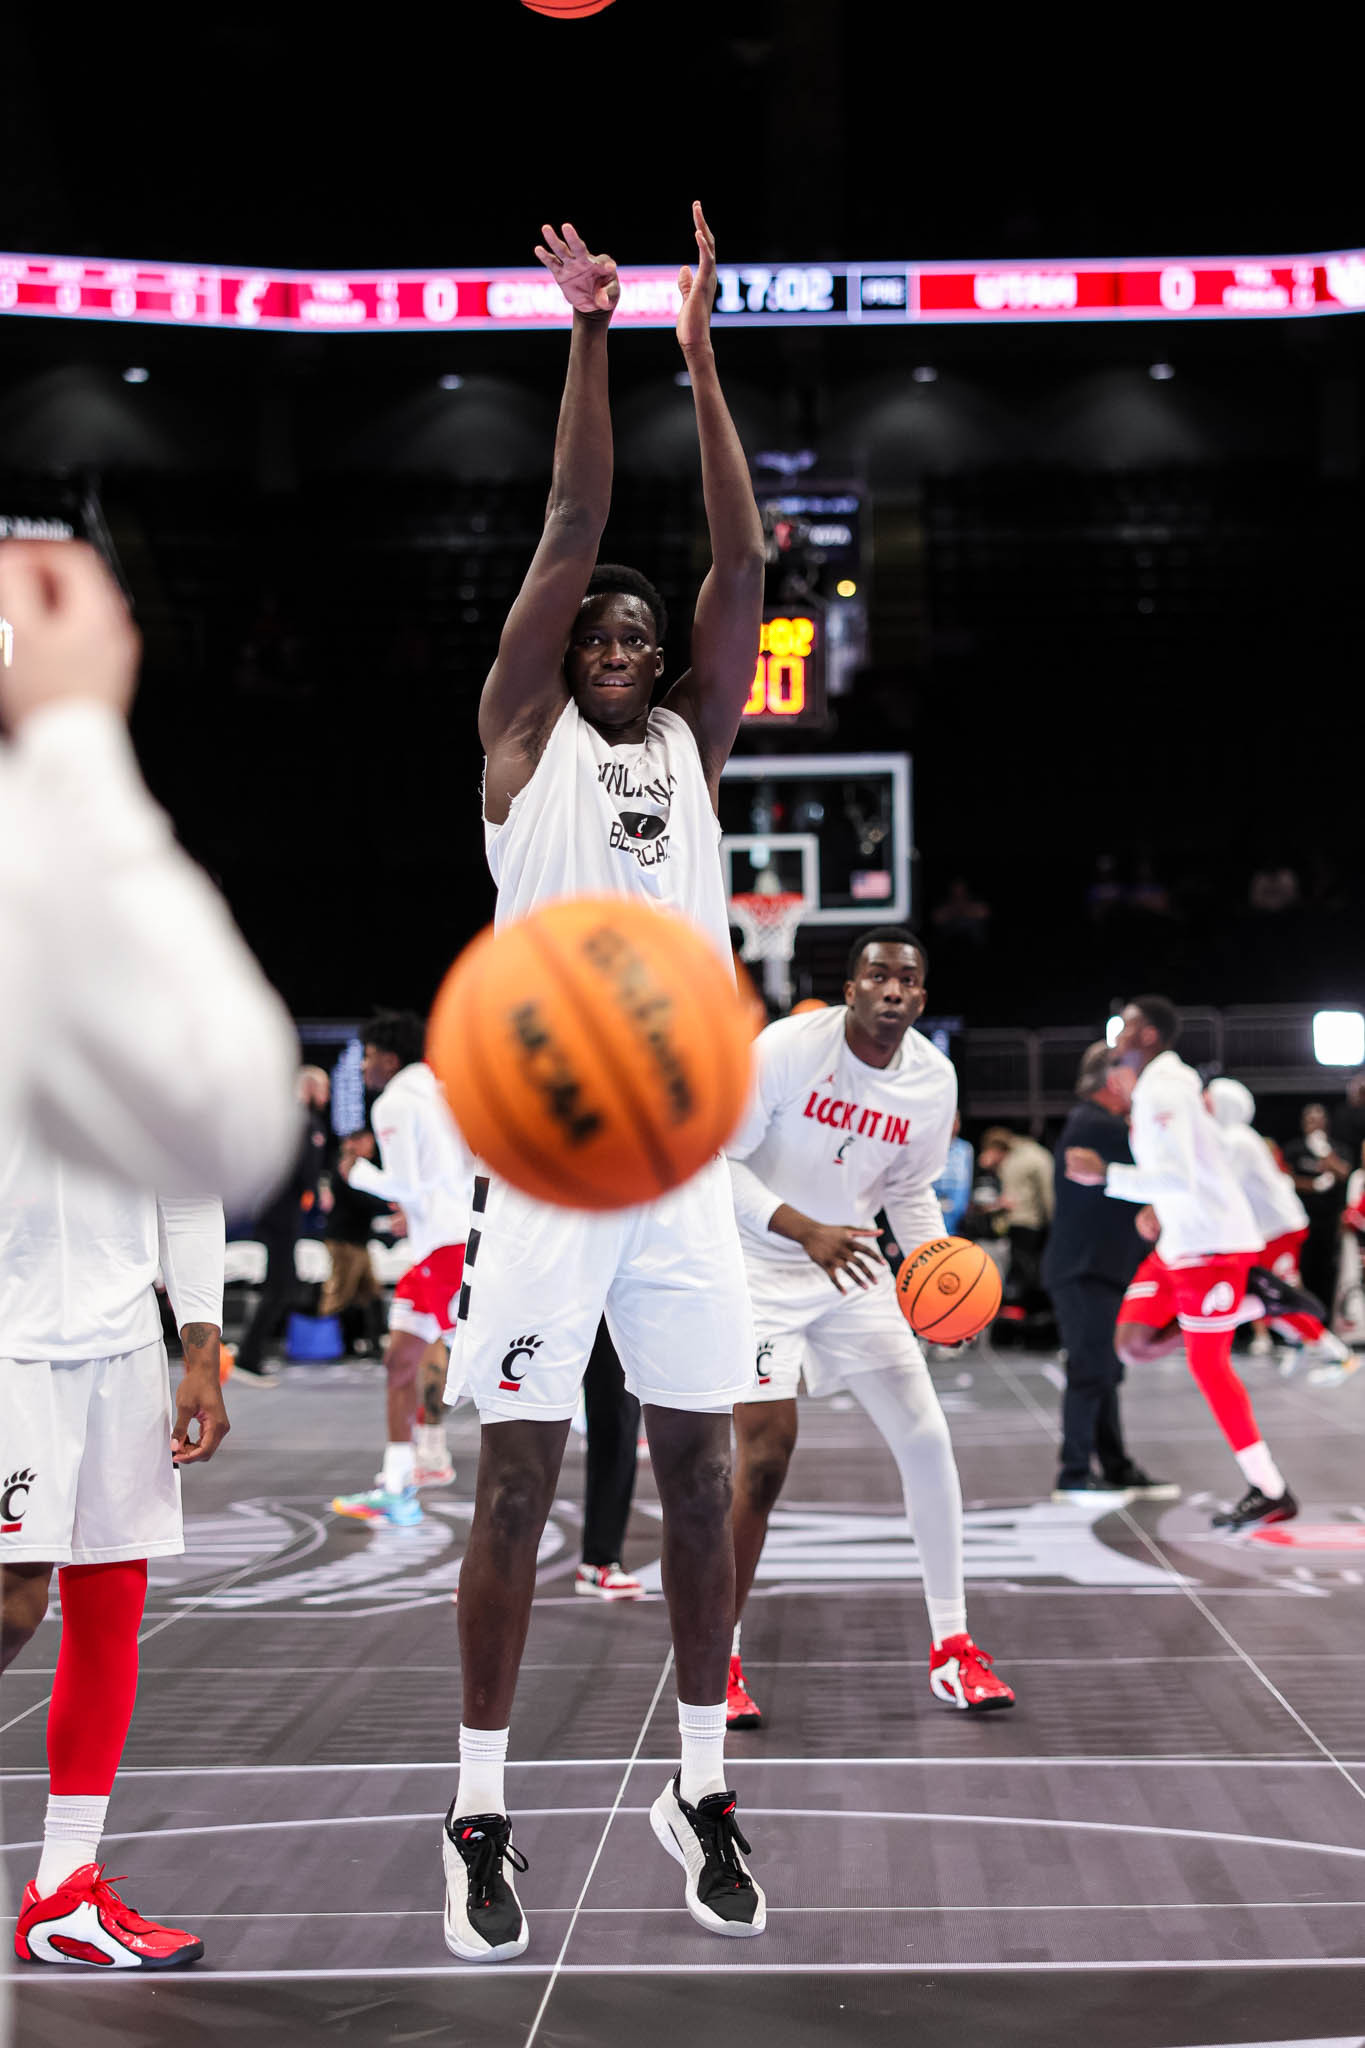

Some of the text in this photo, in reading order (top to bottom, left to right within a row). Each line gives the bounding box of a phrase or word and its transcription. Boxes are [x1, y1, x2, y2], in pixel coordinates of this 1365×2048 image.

[423, 278, 458, 322] 0
[1160, 265, 1196, 311] 0
[803, 1091, 910, 1145] LOCK IT IN
